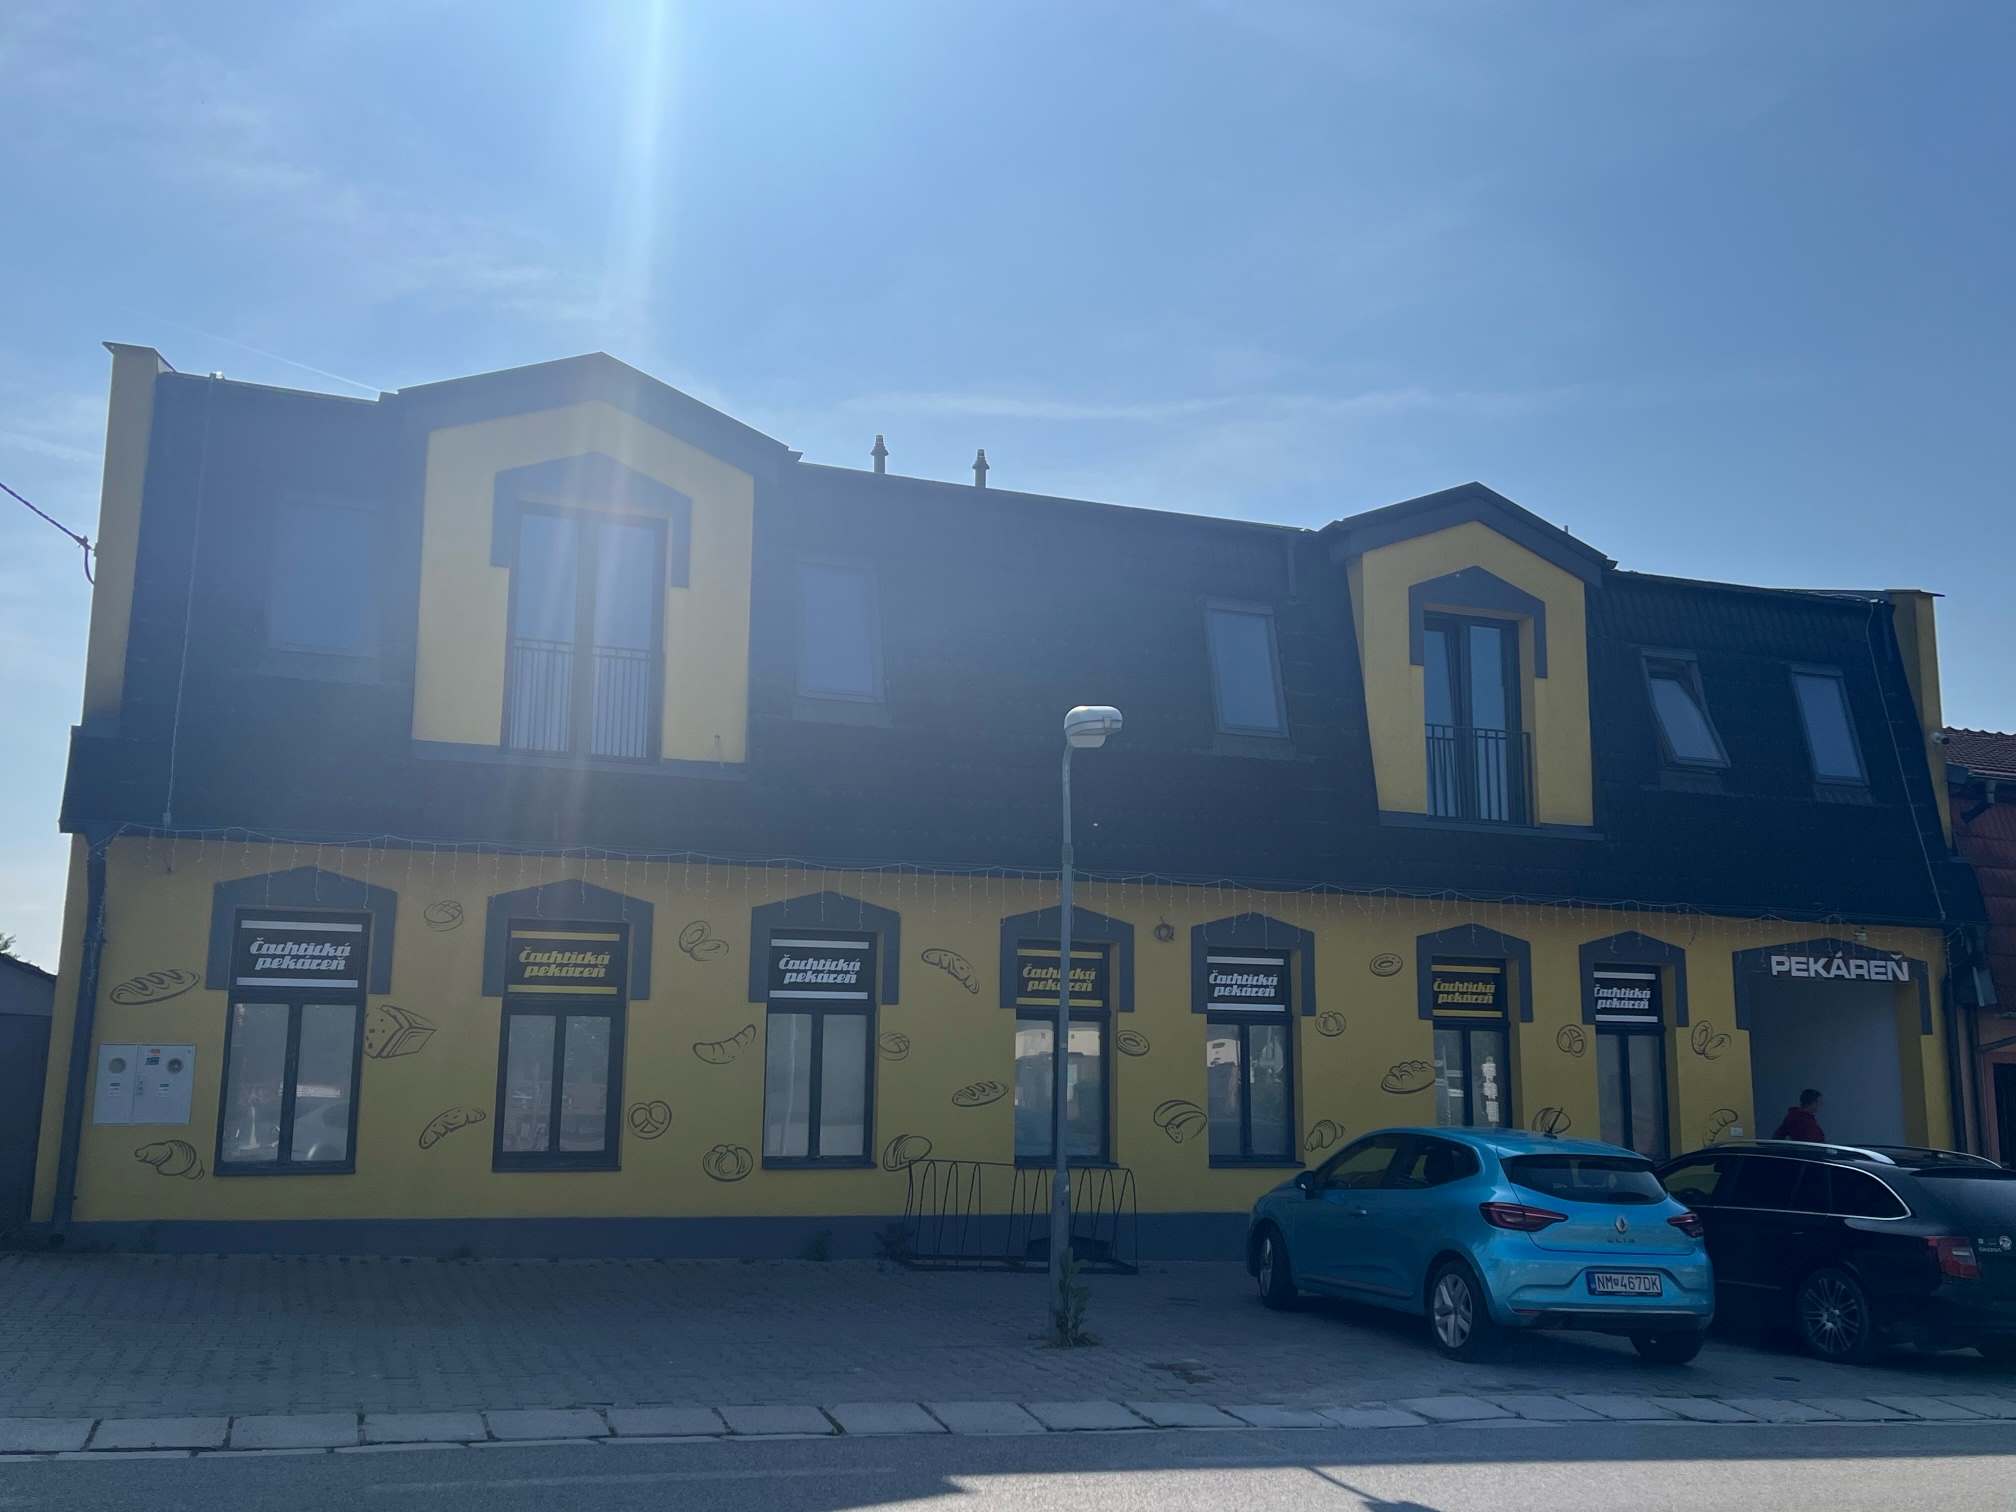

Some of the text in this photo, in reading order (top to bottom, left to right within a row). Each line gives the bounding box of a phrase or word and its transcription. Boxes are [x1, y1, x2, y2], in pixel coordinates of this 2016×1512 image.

[250, 937, 351, 956] Čachtická
[255, 956, 346, 970] pekáreň
[779, 954, 861, 971] Čachtická
[1771, 951, 1910, 982] PEKÁREŇ
[783, 970, 857, 984] pekáreň
[1022, 963, 1096, 980] Čachcká
[1209, 970, 1278, 985] Čachtická
[1027, 979, 1093, 992] pekreň
[1214, 985, 1276, 997] pekáreň
